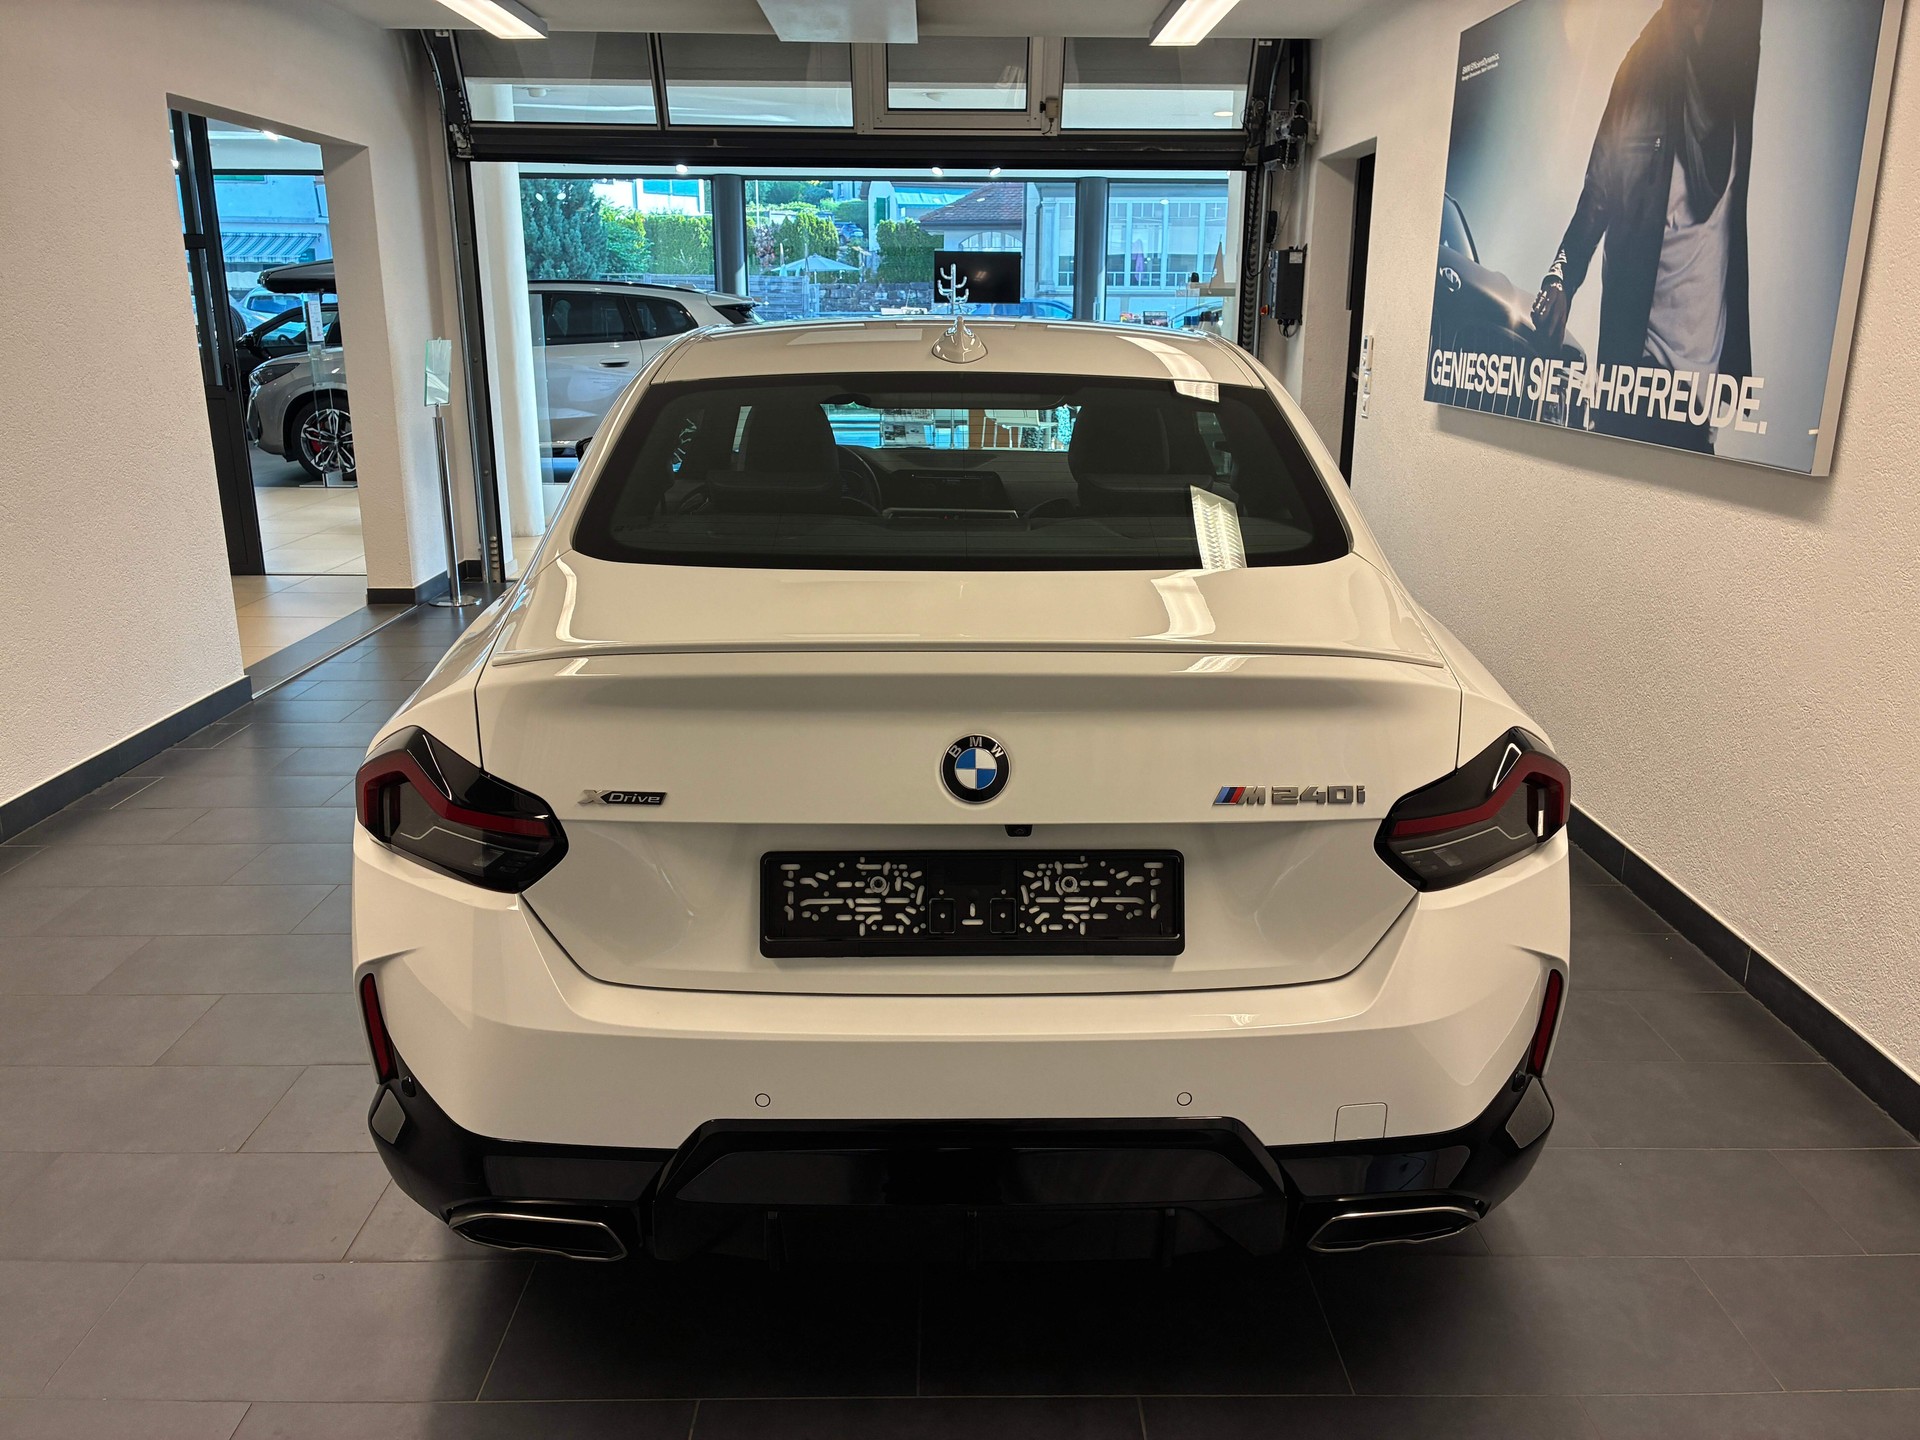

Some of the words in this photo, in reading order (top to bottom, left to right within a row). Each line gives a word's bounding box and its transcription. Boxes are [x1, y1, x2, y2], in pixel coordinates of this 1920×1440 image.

[1431, 348, 1526, 398] GENIESSEN
[1527, 357, 1563, 403] SIE
[1566, 361, 1768, 435] FAHRFREUDE.
[948, 736, 1004, 759] BMW
